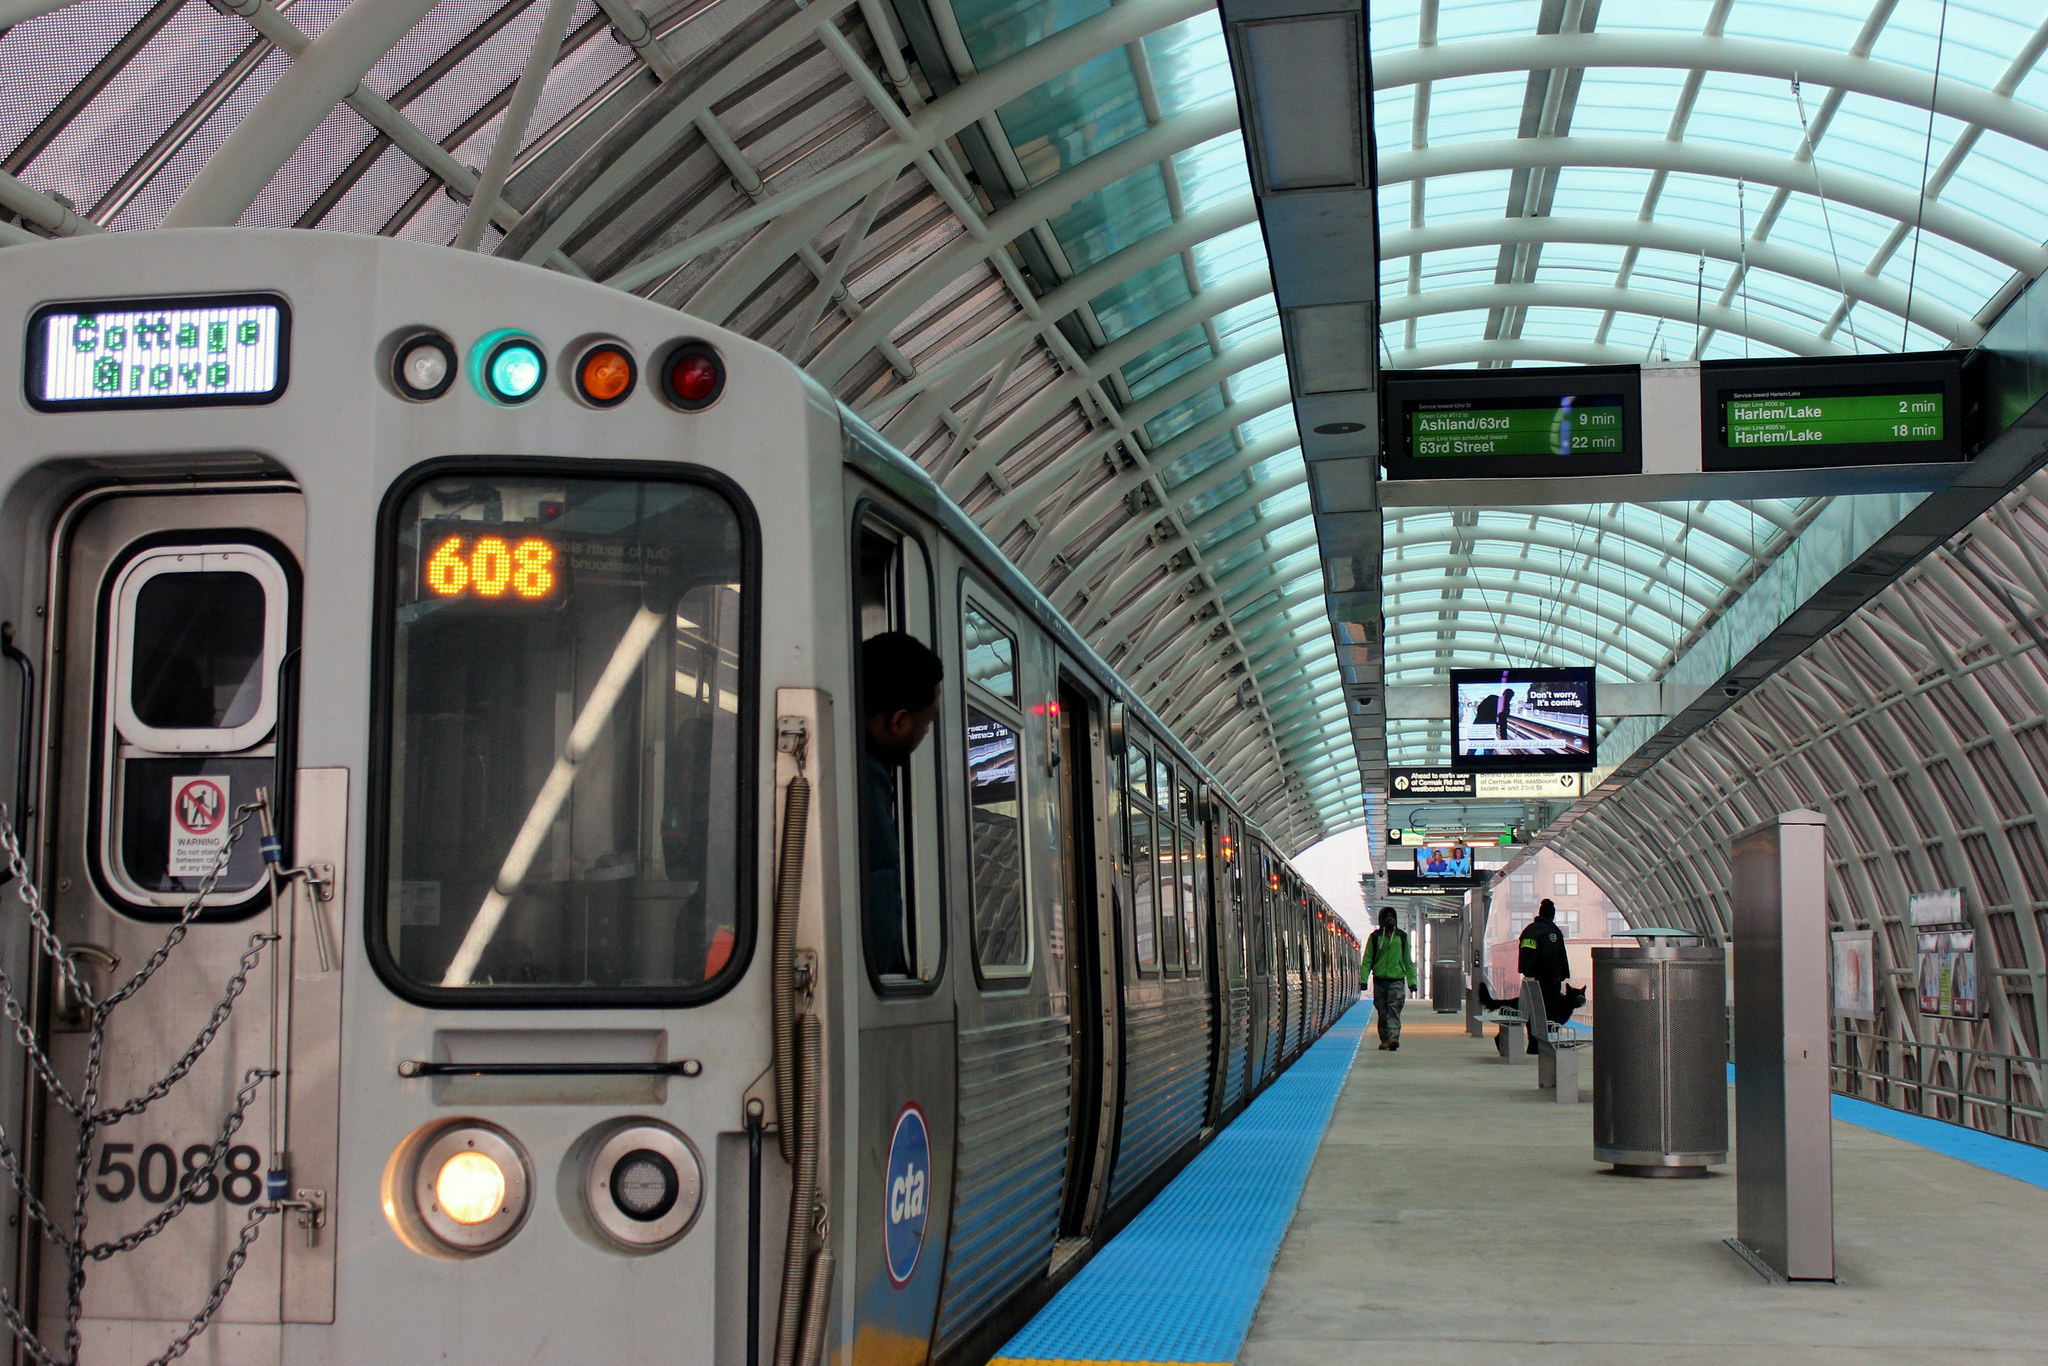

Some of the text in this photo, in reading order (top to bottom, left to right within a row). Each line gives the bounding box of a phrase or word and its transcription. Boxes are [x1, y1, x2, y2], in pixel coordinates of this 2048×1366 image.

[73, 315, 259, 353] Cottage
[94, 355, 230, 391] Grove
[1734, 406, 1822, 420] Harlem/Lake
[1899, 400, 1936, 413] 2 min
[1420, 417, 1510, 431] Ashland/63rd
[1580, 413, 1615, 425] 9 min
[1735, 429, 1823, 443] Harlem/Lake
[1891, 424, 1936, 437] 18 min
[1420, 441, 1495, 454] 63rd Street
[1572, 436, 1616, 448] 22 min
[428, 536, 553, 597] 608
[1530, 691, 1578, 700] Don't worry,
[1550, 699, 1583, 708] coming.
[177, 838, 220, 847] WARNING
[95, 1143, 263, 1206] 5088
[891, 1162, 925, 1225] cta
